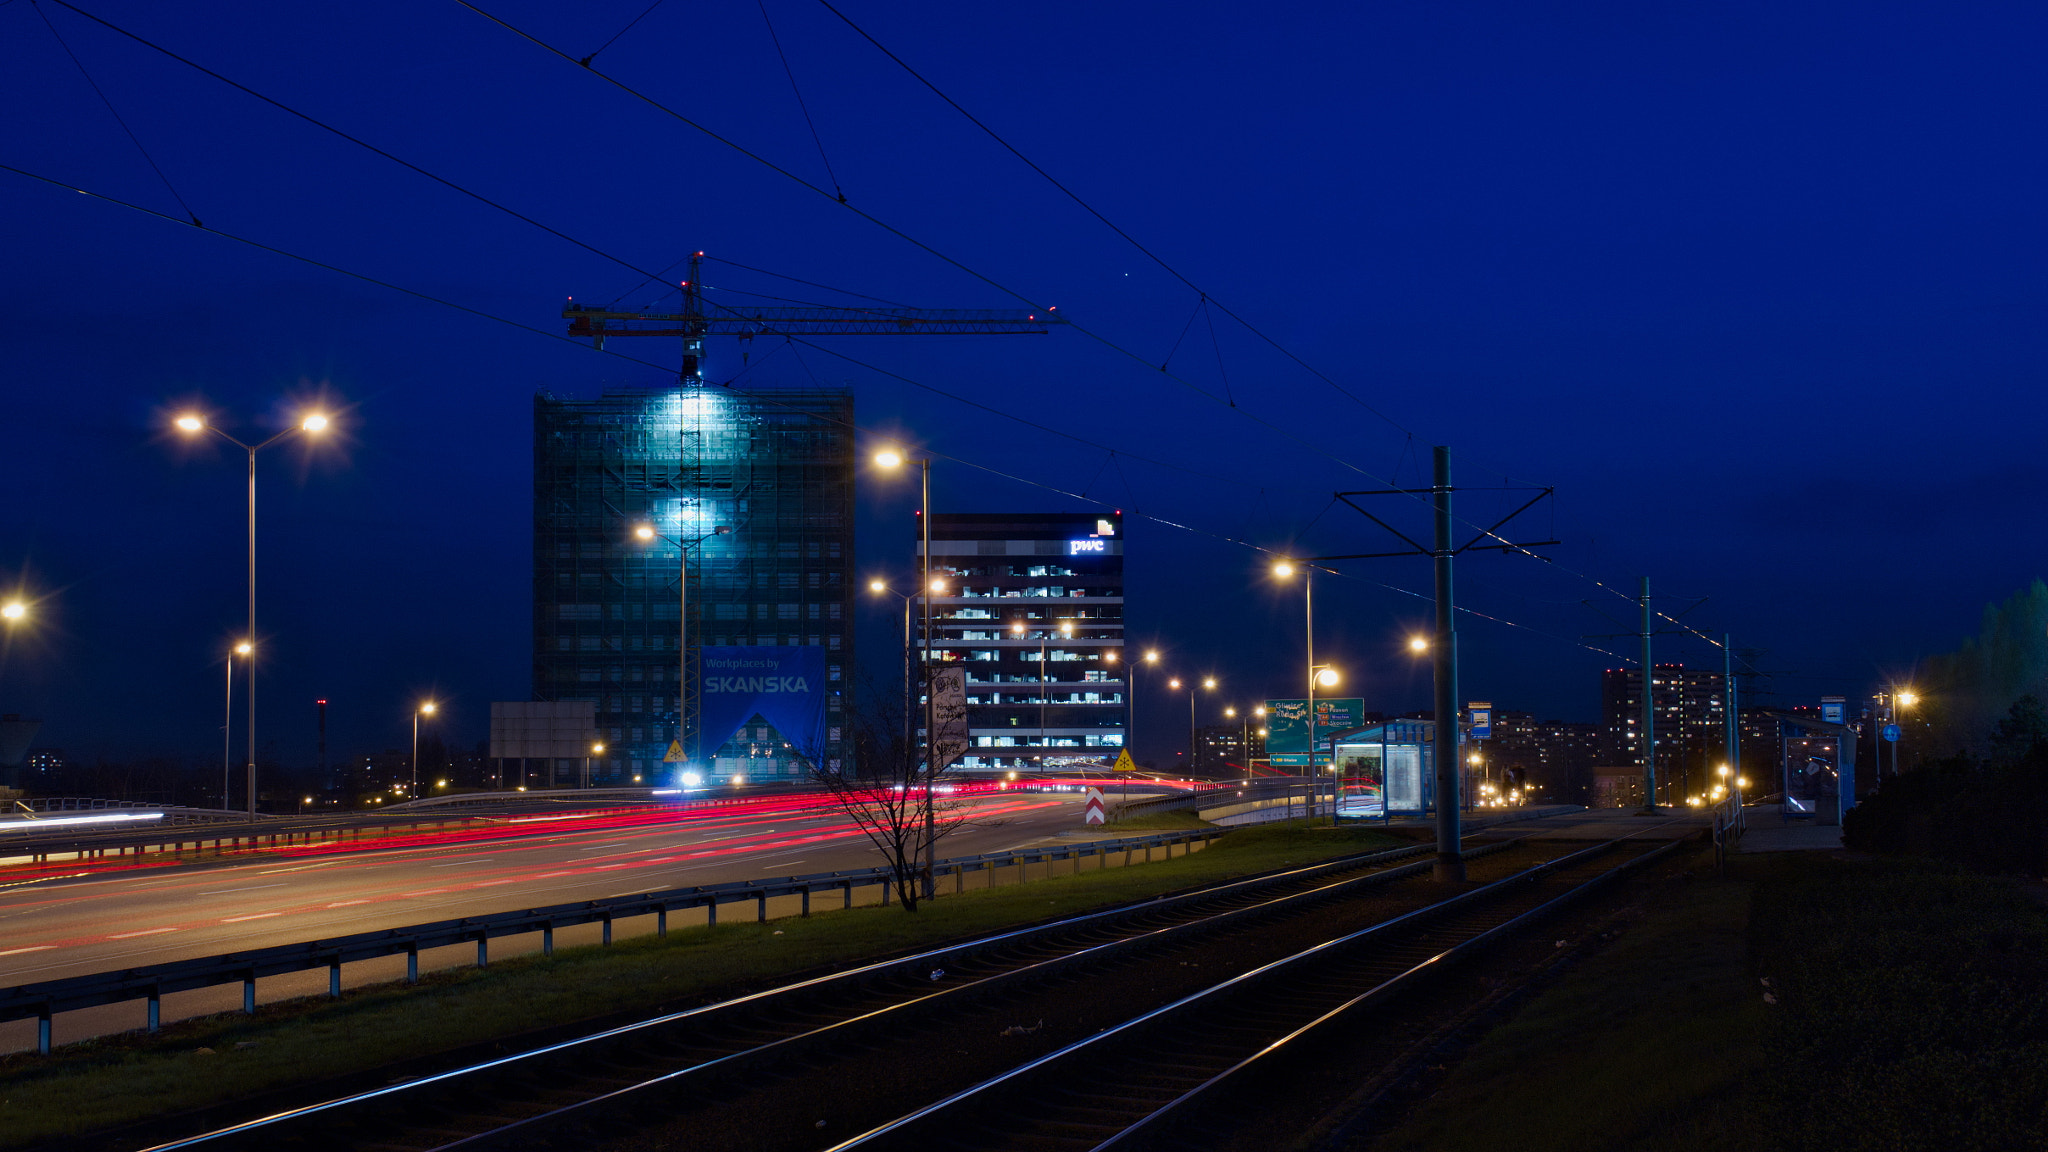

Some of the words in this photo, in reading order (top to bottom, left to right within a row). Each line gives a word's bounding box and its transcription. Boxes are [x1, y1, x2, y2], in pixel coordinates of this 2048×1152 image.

[1070, 540, 1104, 555] pwc
[706, 659, 765, 670] Workplaces
[767, 659, 780, 670] by
[705, 677, 809, 693] SKANSKA
